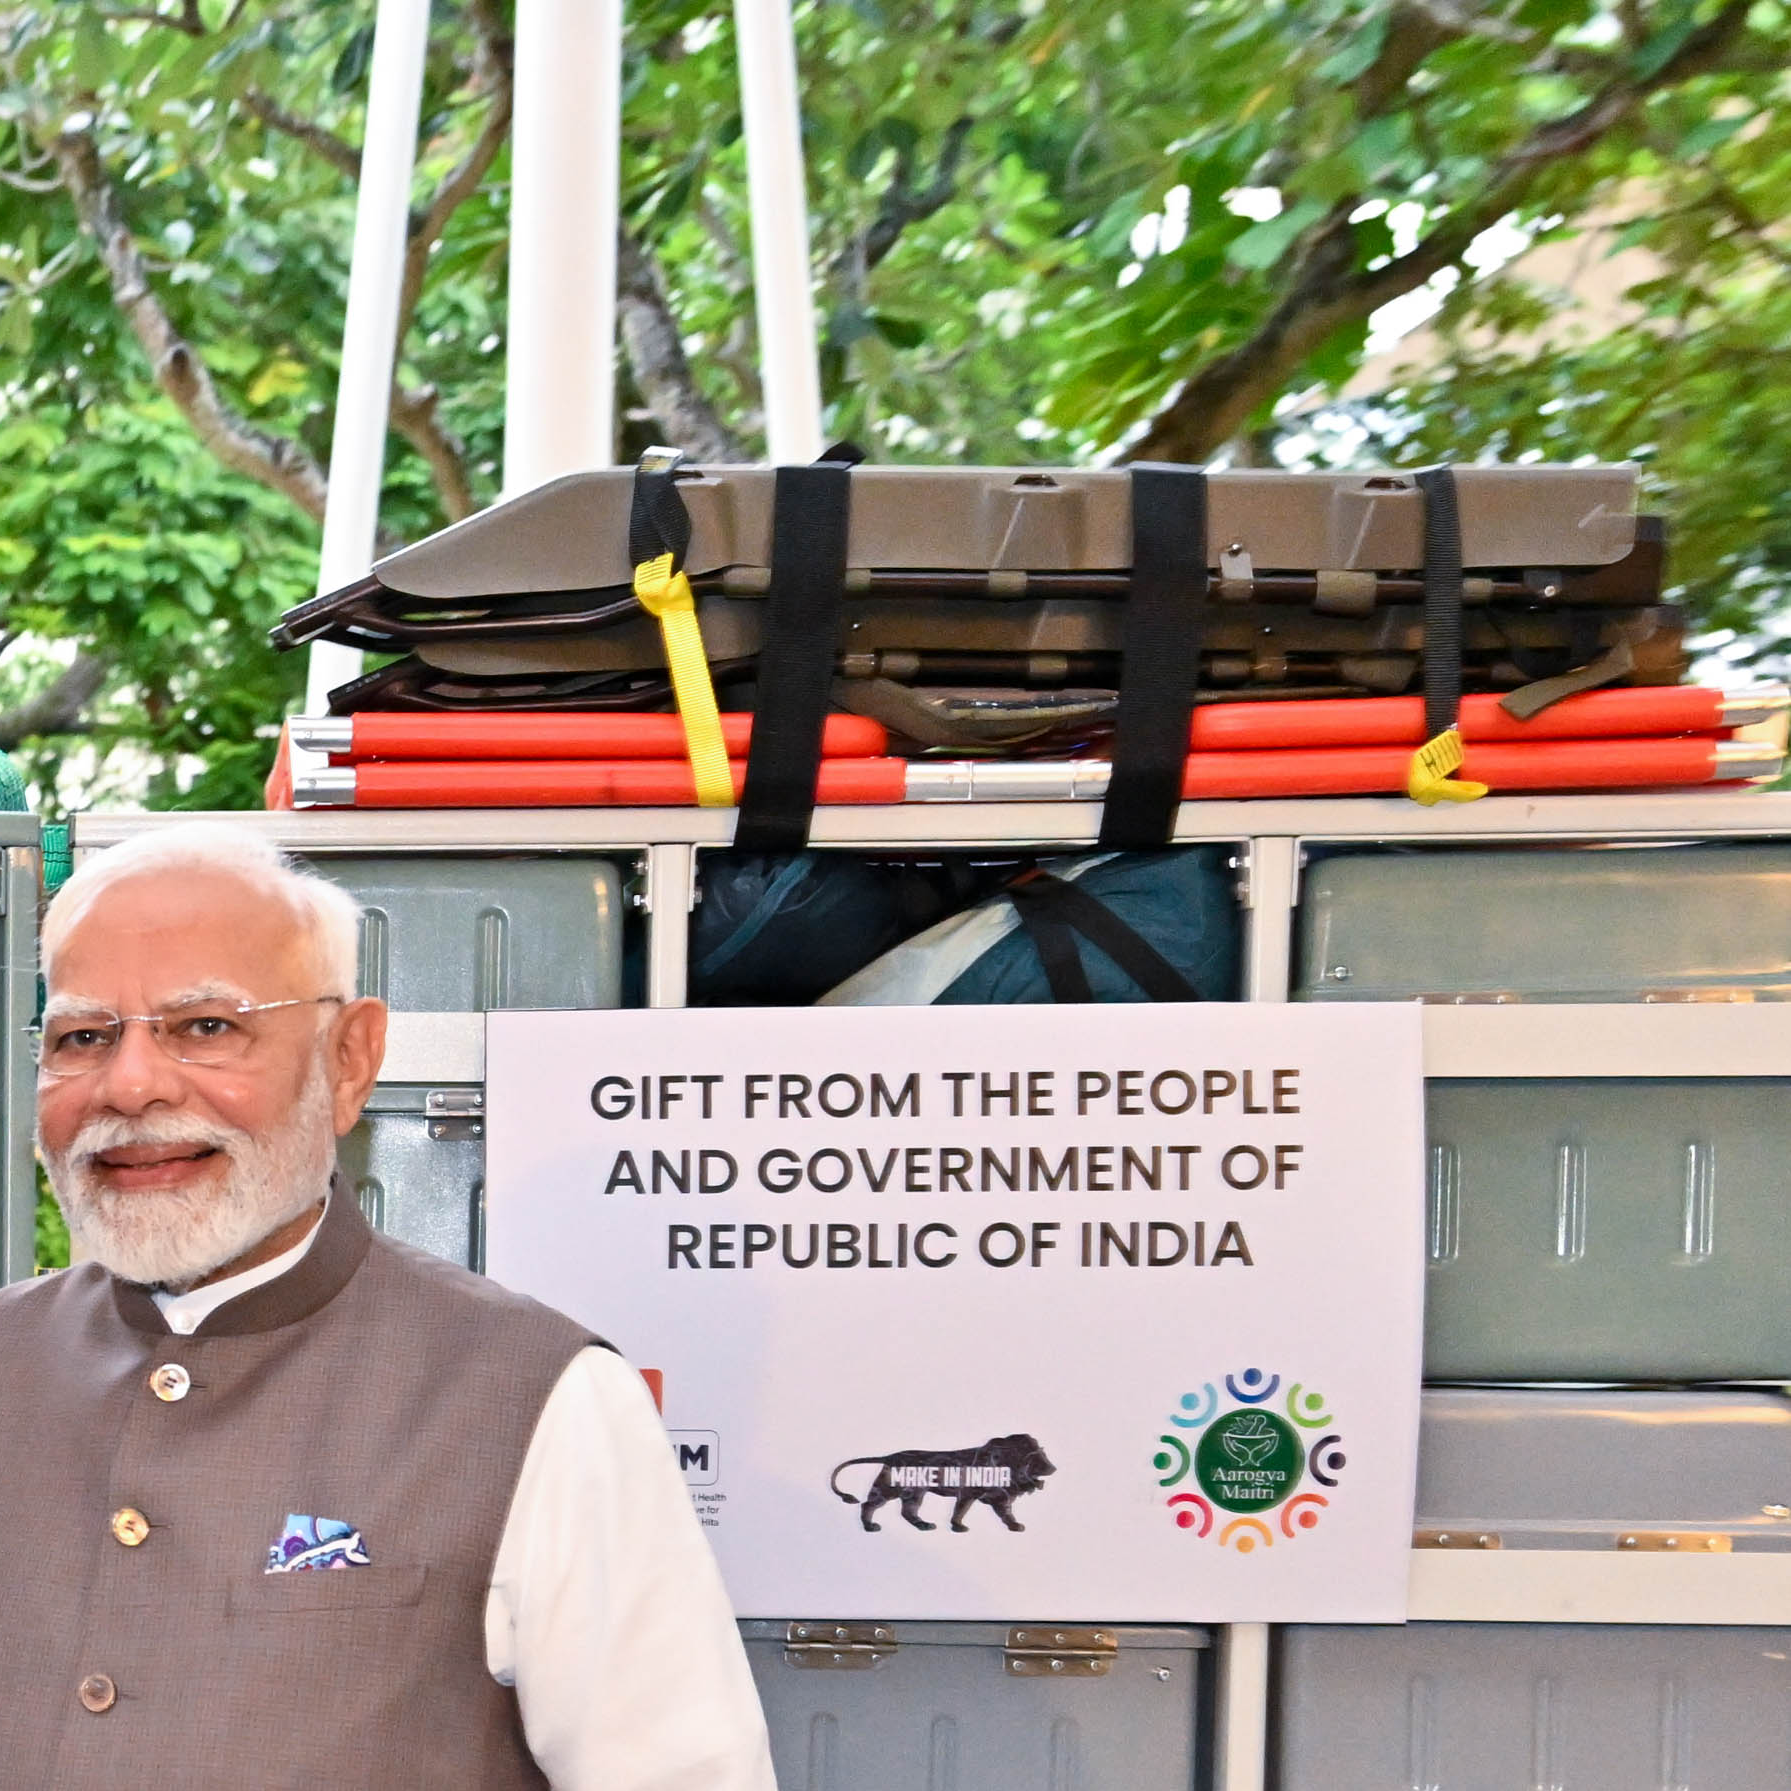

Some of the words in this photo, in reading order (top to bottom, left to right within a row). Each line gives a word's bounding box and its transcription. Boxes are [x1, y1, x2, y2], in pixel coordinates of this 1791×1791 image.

[591, 1074, 725, 1121] GIFT
[744, 1072, 922, 1120] FROM
[942, 1071, 1055, 1118] THE
[1078, 1068, 1301, 1116] PEOPLE
[604, 1148, 738, 1196] AND
[758, 1145, 1203, 1194] GOVERNMENT
[1220, 1143, 1304, 1191] OF
[669, 1221, 958, 1270] REPUBLIC
[978, 1220, 1063, 1269] OF
[1081, 1220, 1253, 1268] INDIA
[890, 1467, 939, 1487] MAKE
[944, 1467, 960, 1487] IN
[966, 1467, 1010, 1487] INDIA
[1212, 1467, 1285, 1486] Aarogya
[698, 1493, 727, 1502] Health
[1222, 1482, 1274, 1499] Maitri
[707, 1506, 719, 1514] for
[702, 1518, 719, 1526] Hita
